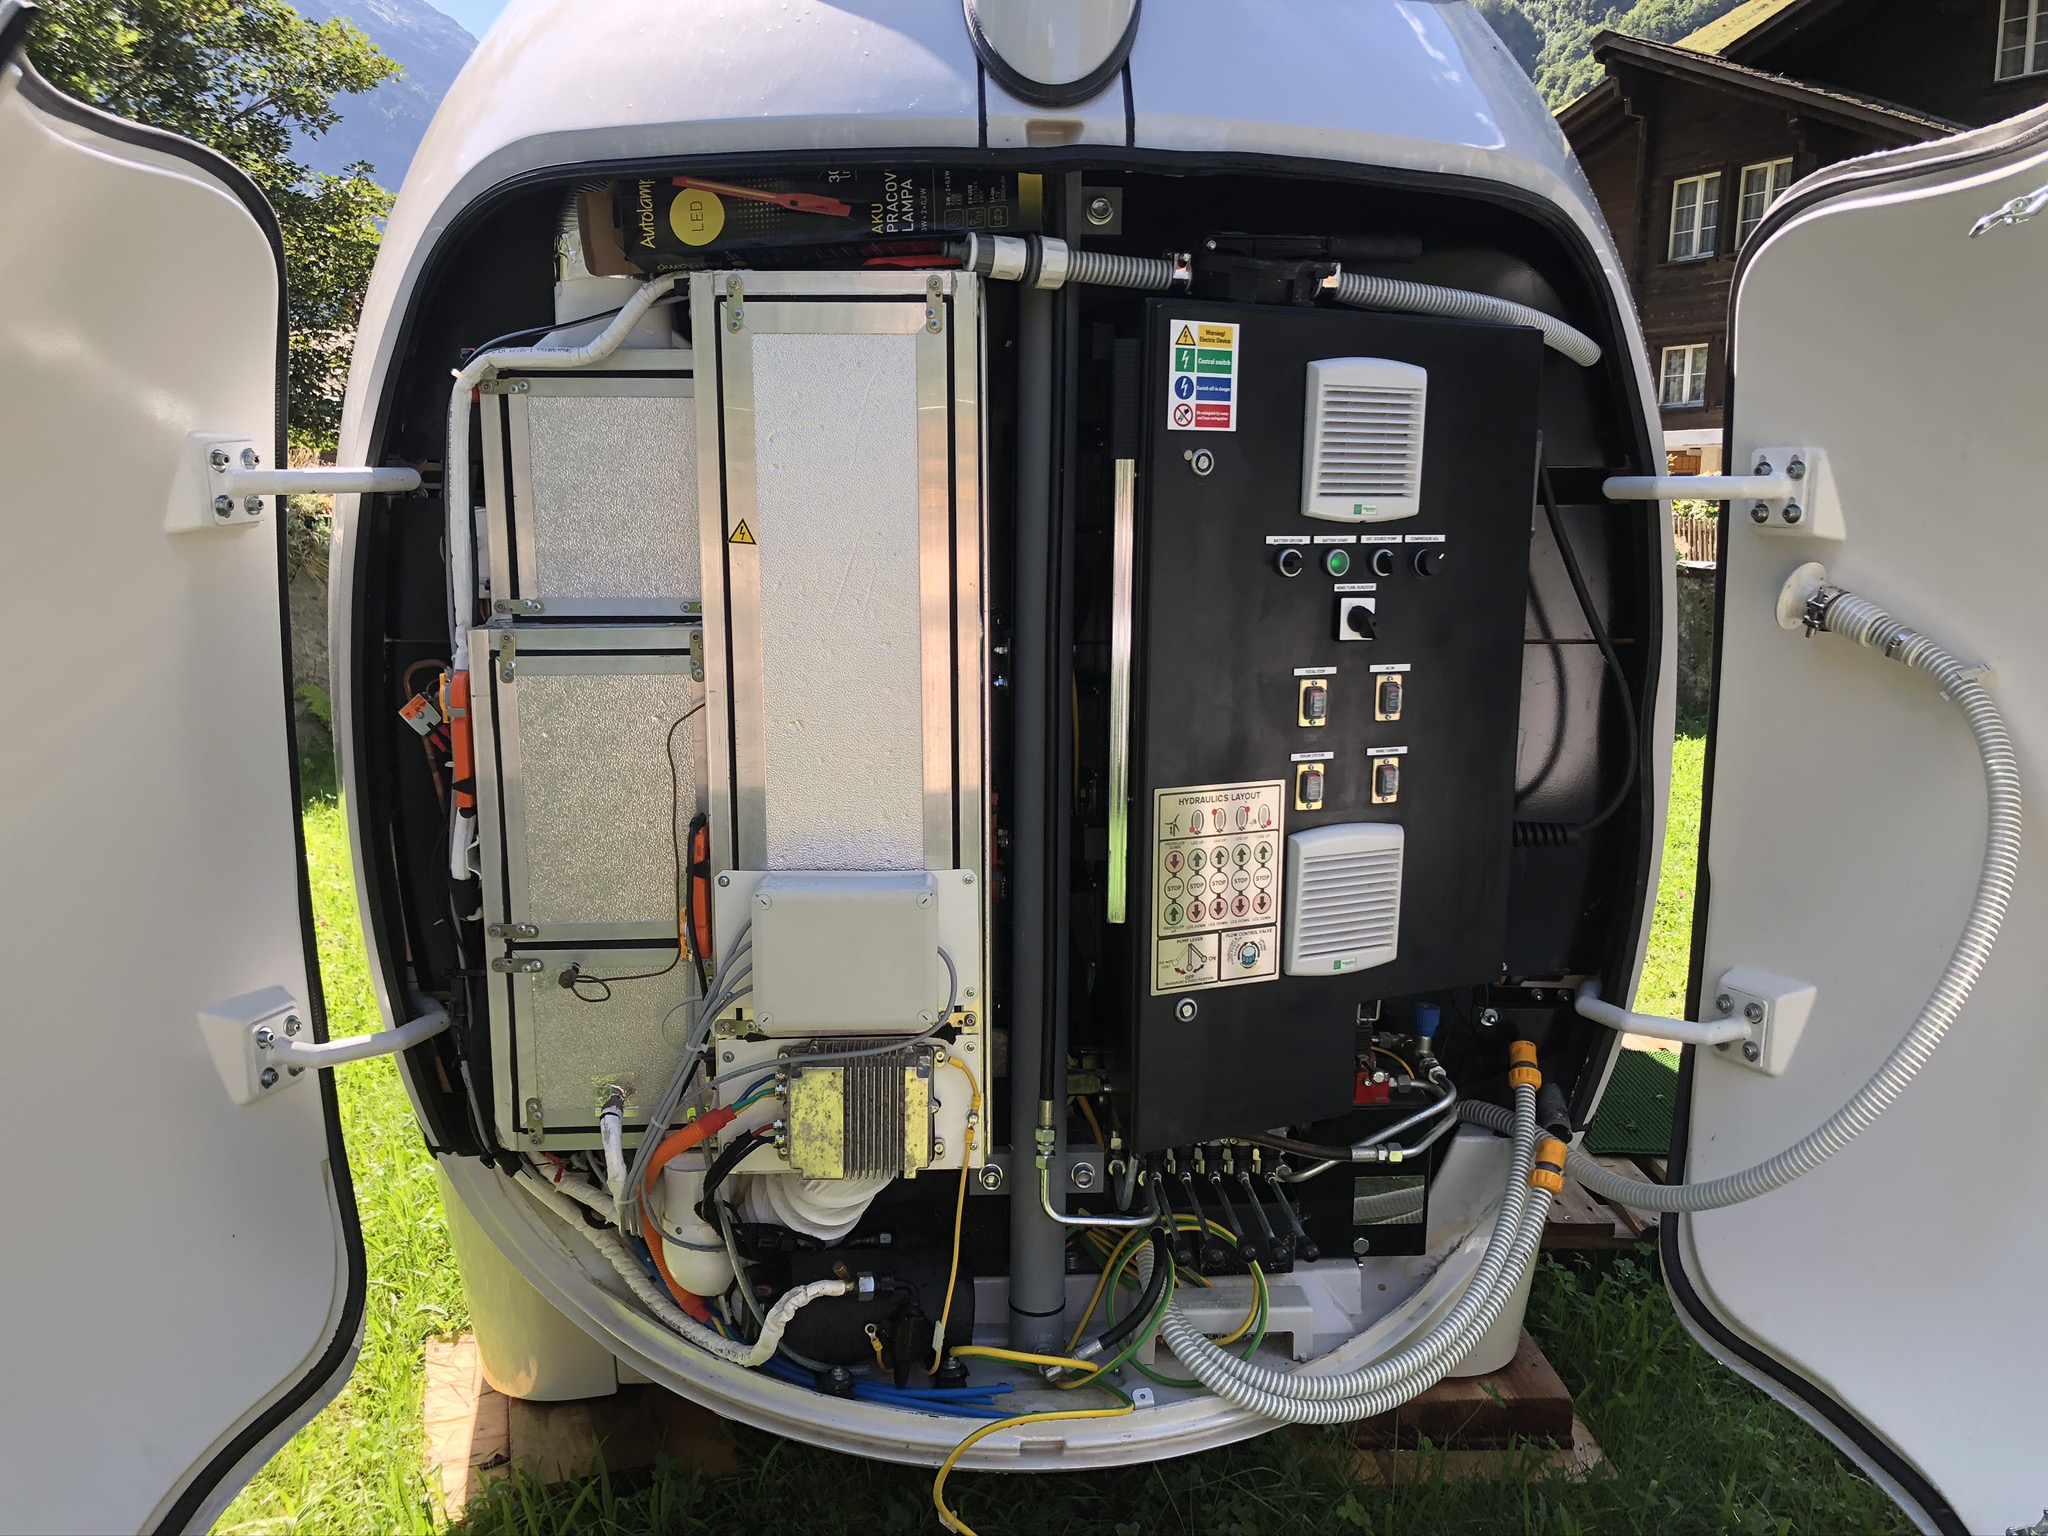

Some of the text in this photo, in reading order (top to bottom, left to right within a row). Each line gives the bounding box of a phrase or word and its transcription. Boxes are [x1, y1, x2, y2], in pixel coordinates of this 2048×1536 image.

[690, 200, 704, 232] LED
[884, 169, 898, 232] PRACOV
[900, 178, 914, 232] LAMPA
[871, 203, 884, 234] AKU
[1205, 329, 1226, 338] Warning!
[1178, 792, 1261, 806] HYDRAULICS LAYOUT
